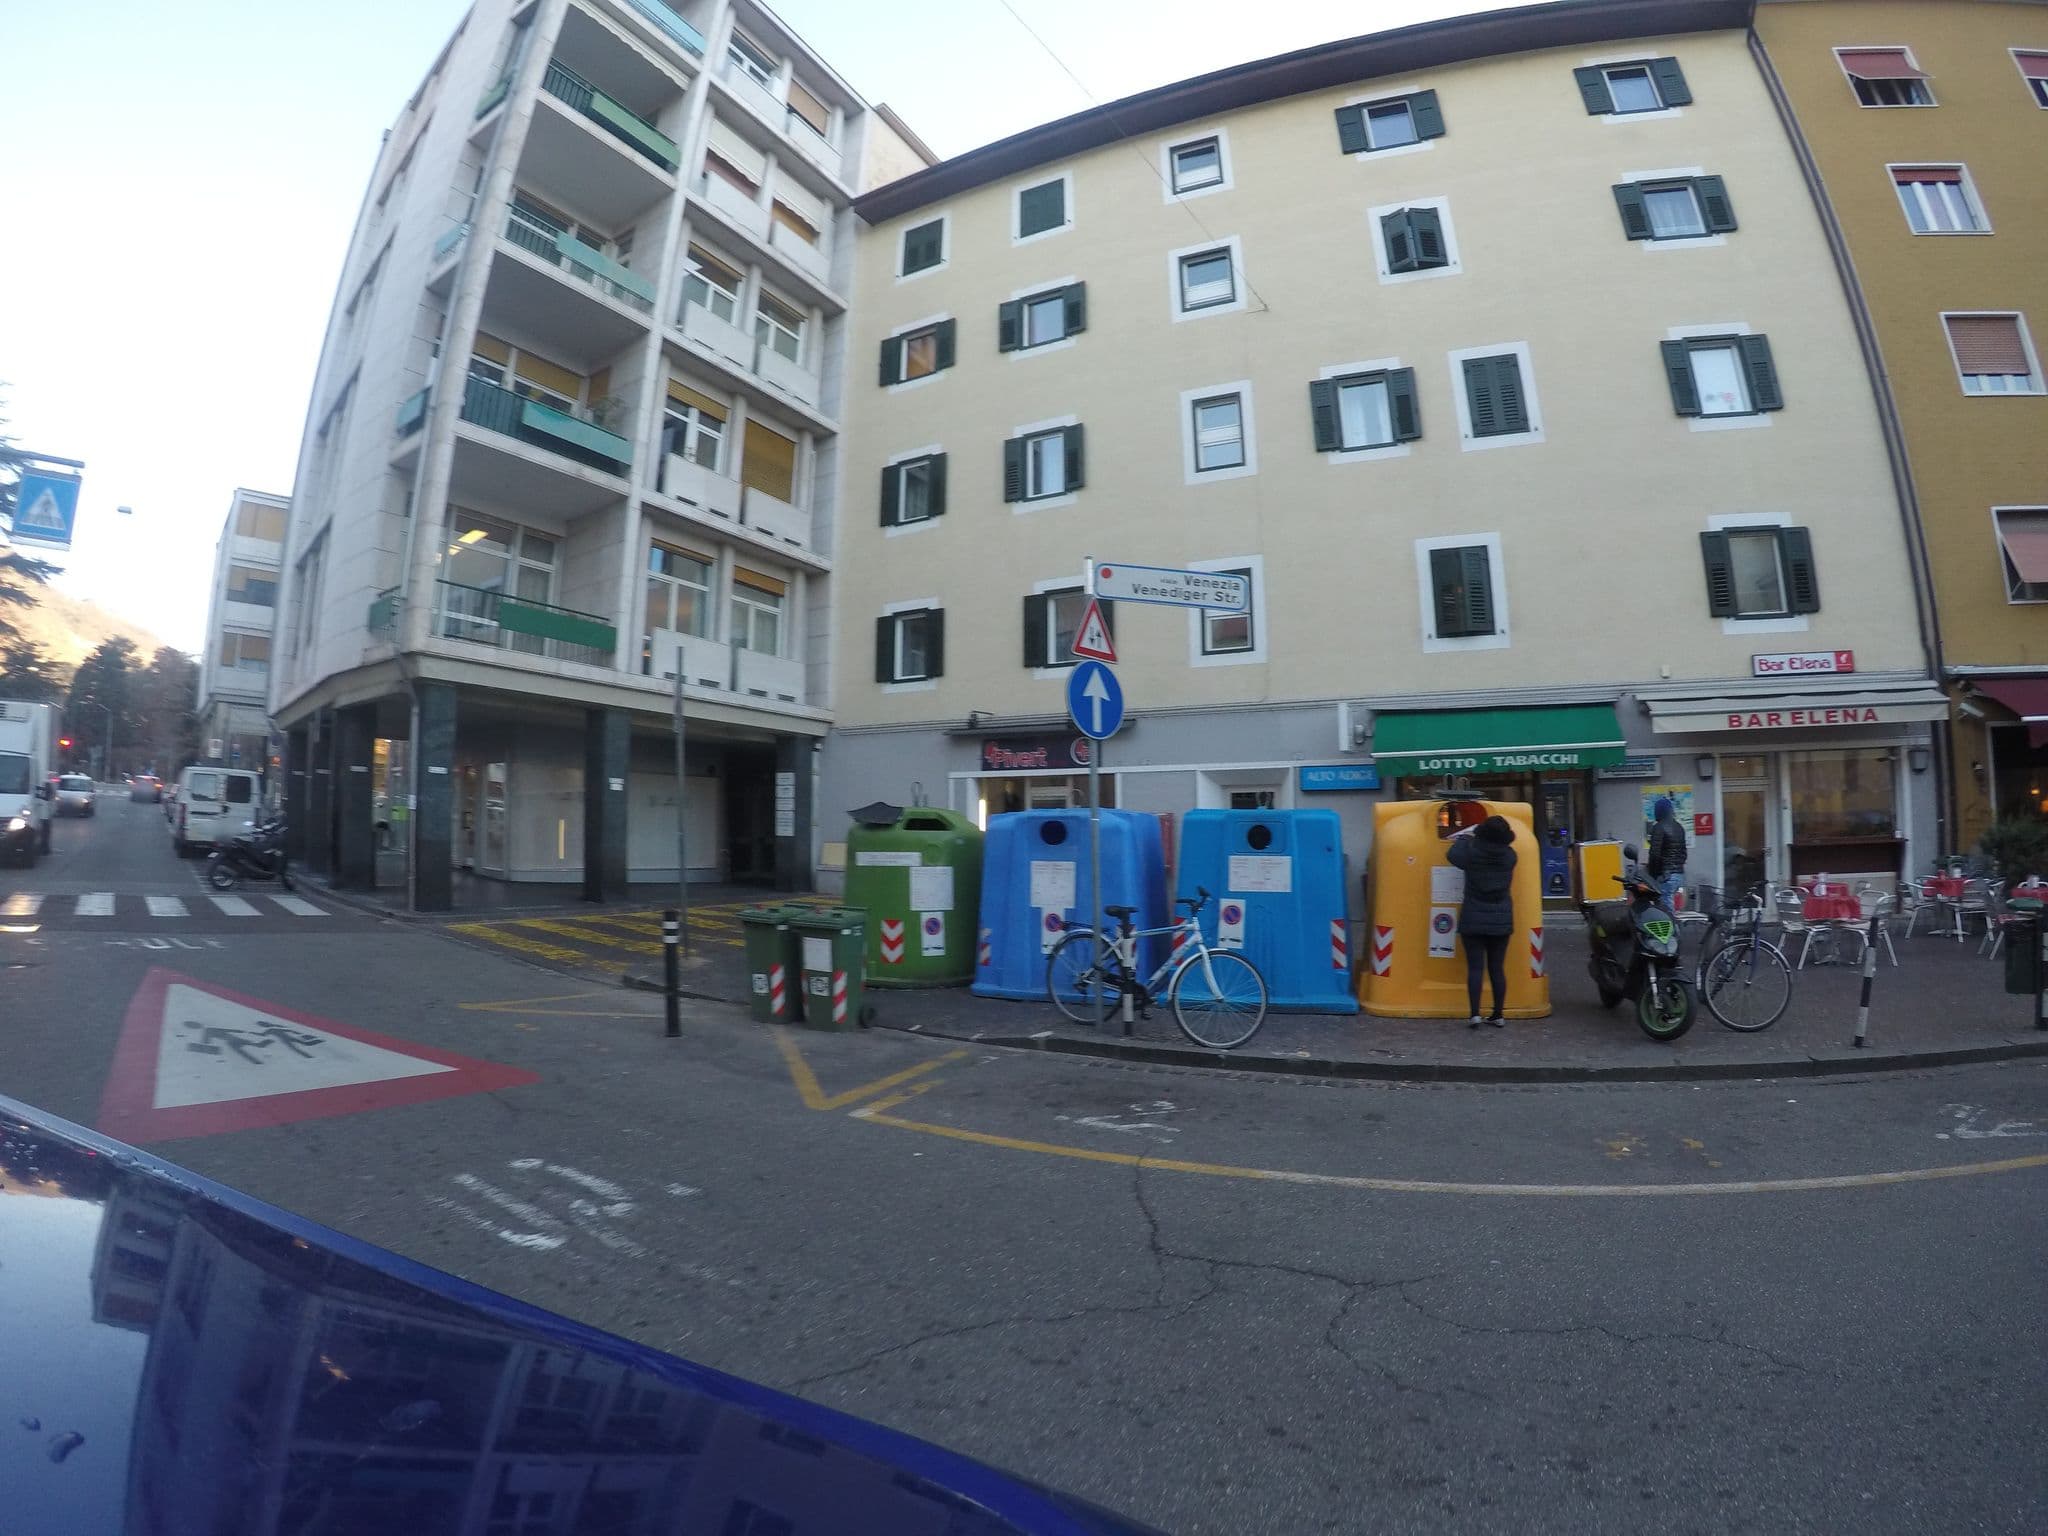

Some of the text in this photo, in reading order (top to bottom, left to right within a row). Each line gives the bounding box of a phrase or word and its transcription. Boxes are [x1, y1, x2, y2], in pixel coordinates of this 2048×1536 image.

[1184, 575, 1240, 591] Venezia
[1132, 583, 1240, 604] Venediger Str.
[1758, 656, 1832, 672] Bar Elena
[1728, 708, 1879, 728] BAR ELENA
[1419, 758, 1477, 770] LOTTO
[1493, 754, 1579, 767] TABACCHI
